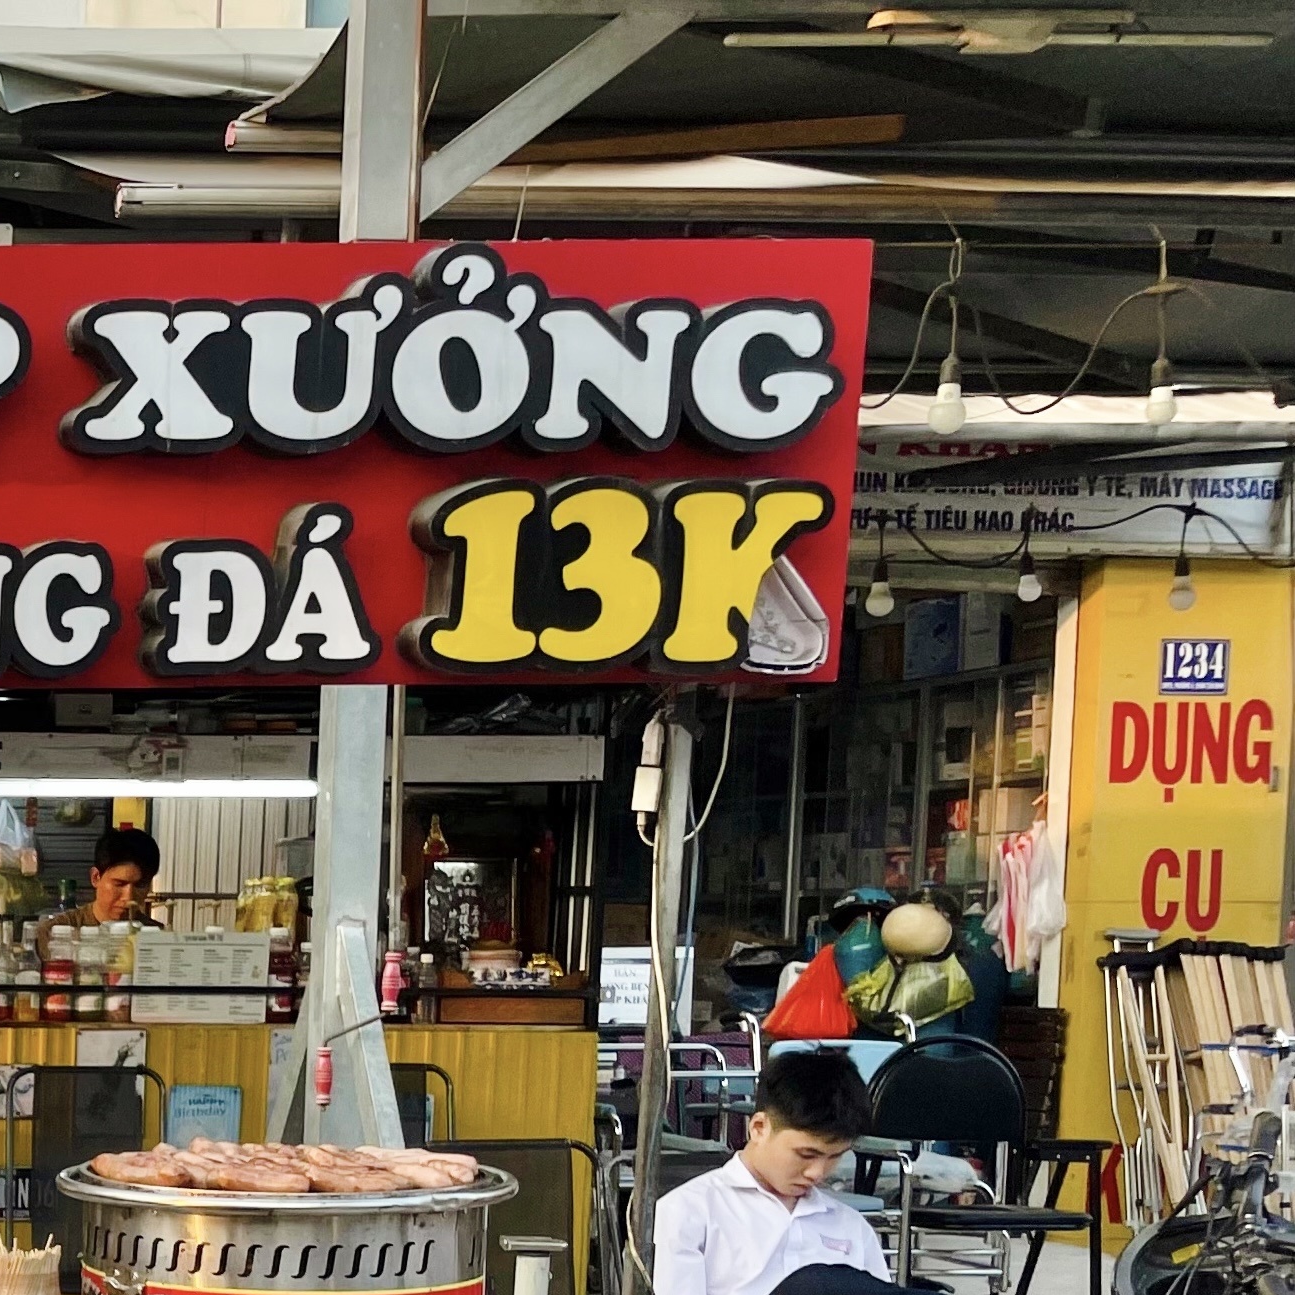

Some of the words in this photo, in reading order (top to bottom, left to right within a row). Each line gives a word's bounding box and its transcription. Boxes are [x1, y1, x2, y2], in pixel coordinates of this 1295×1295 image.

[92, 252, 837, 443] XƯỞNG
[166, 512, 373, 665] ĐÁ
[427, 488, 825, 665] 13K
[1163, 642, 1225, 679] 1234
[1108, 700, 1273, 803] DỤNG
